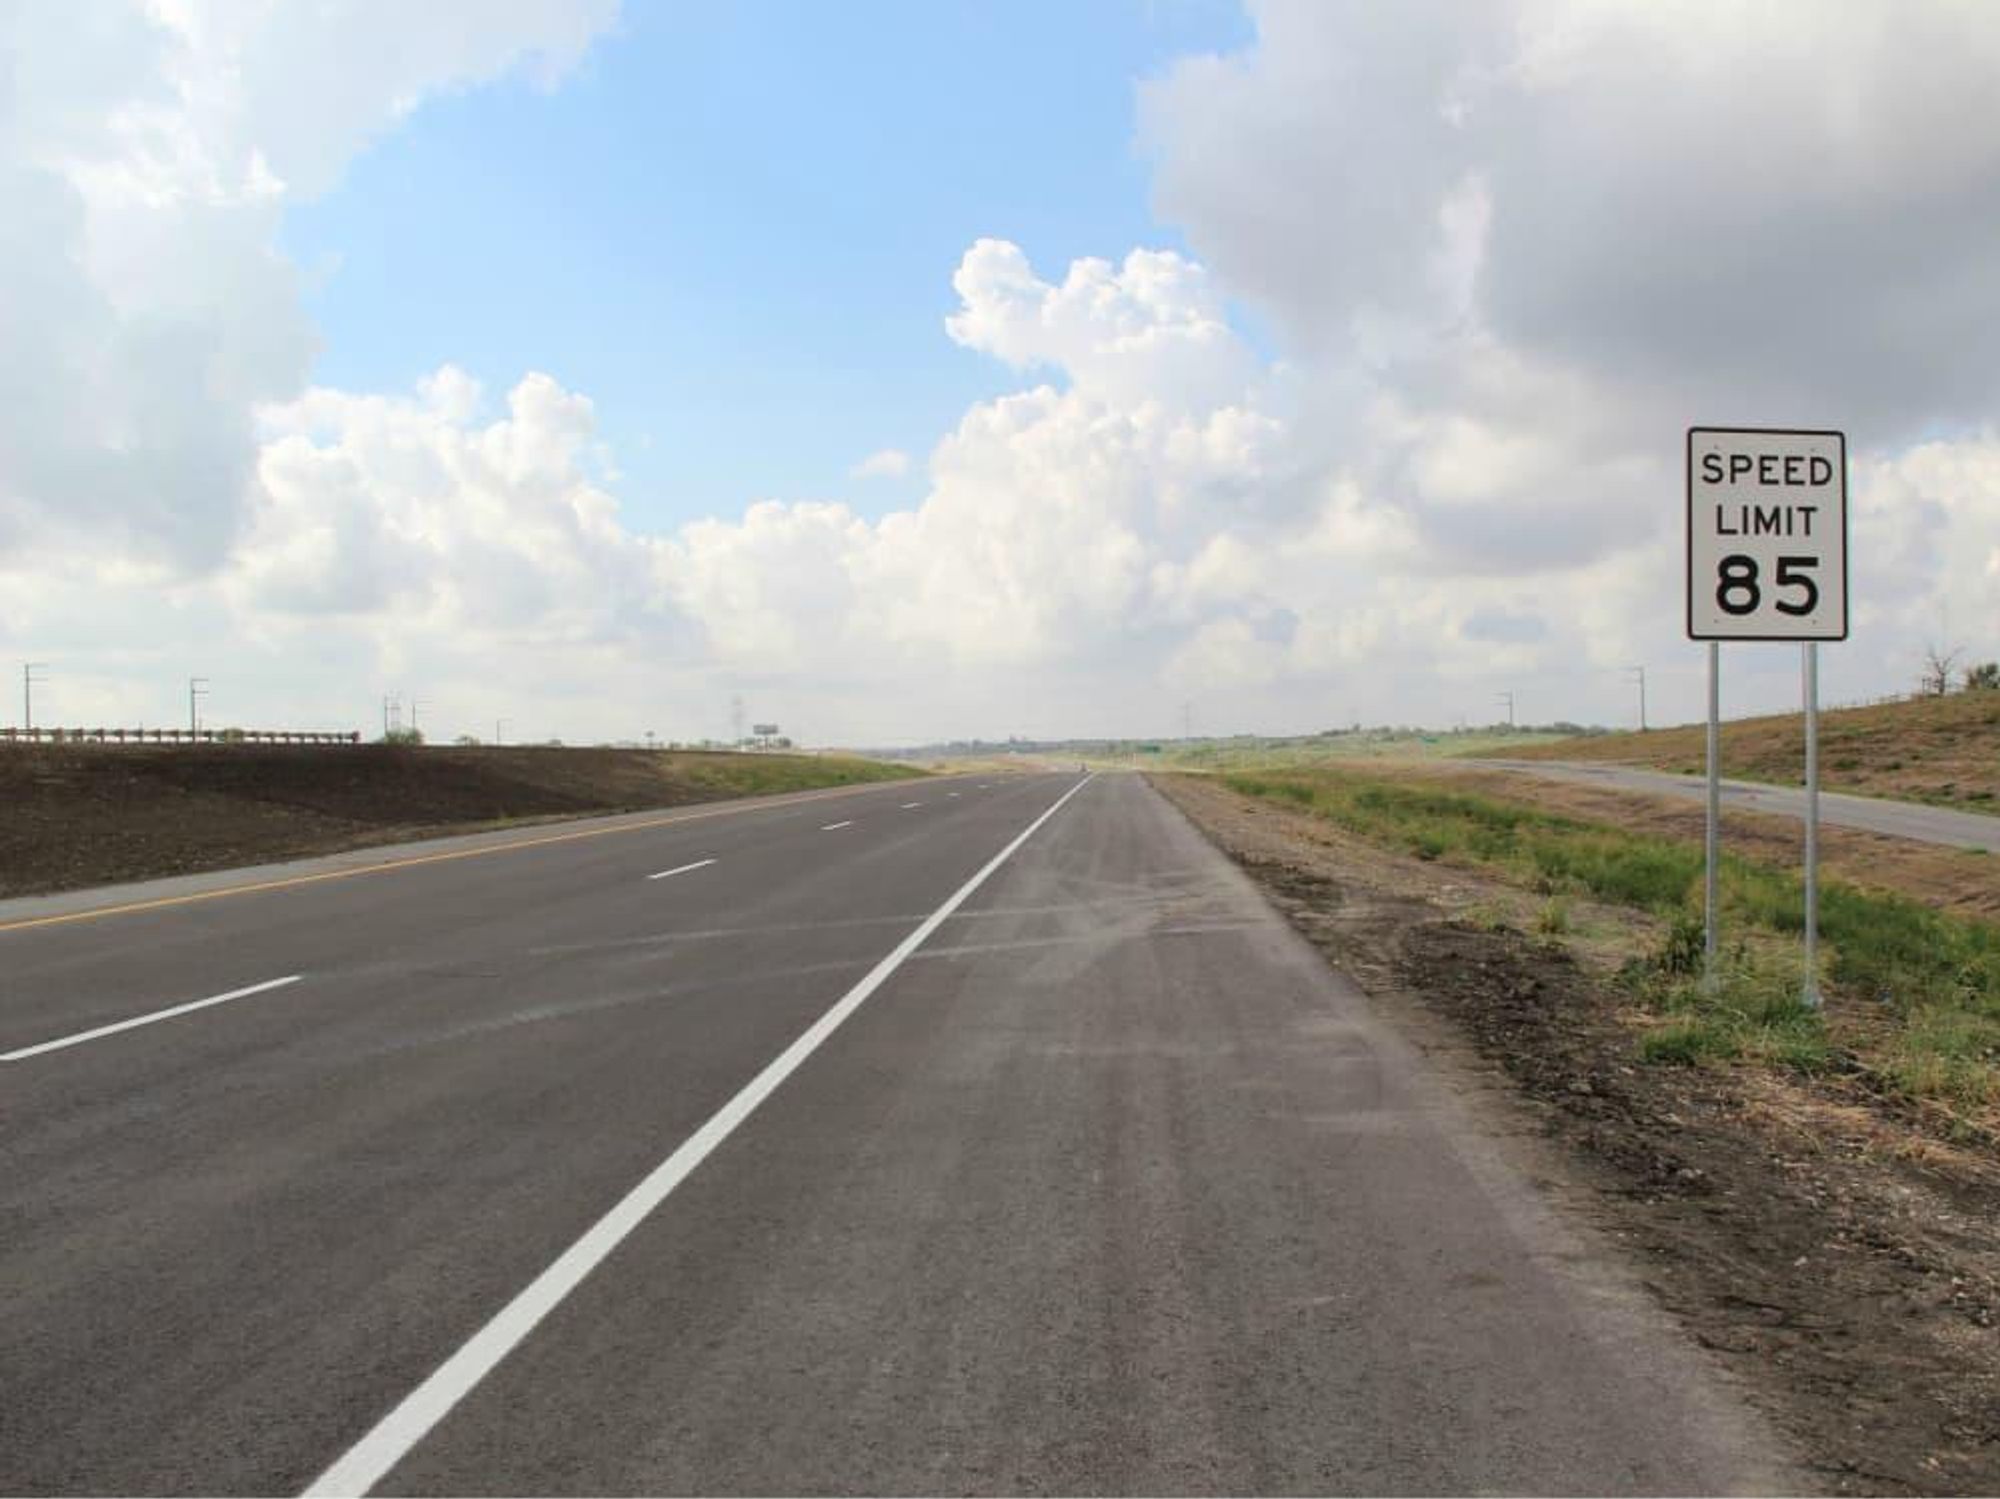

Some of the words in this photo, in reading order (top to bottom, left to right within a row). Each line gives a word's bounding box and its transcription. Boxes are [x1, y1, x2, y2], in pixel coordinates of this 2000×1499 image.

[1702, 453, 1833, 487] SPEED
[1716, 504, 1818, 536] LIMIT
[1715, 554, 1819, 617] 85
